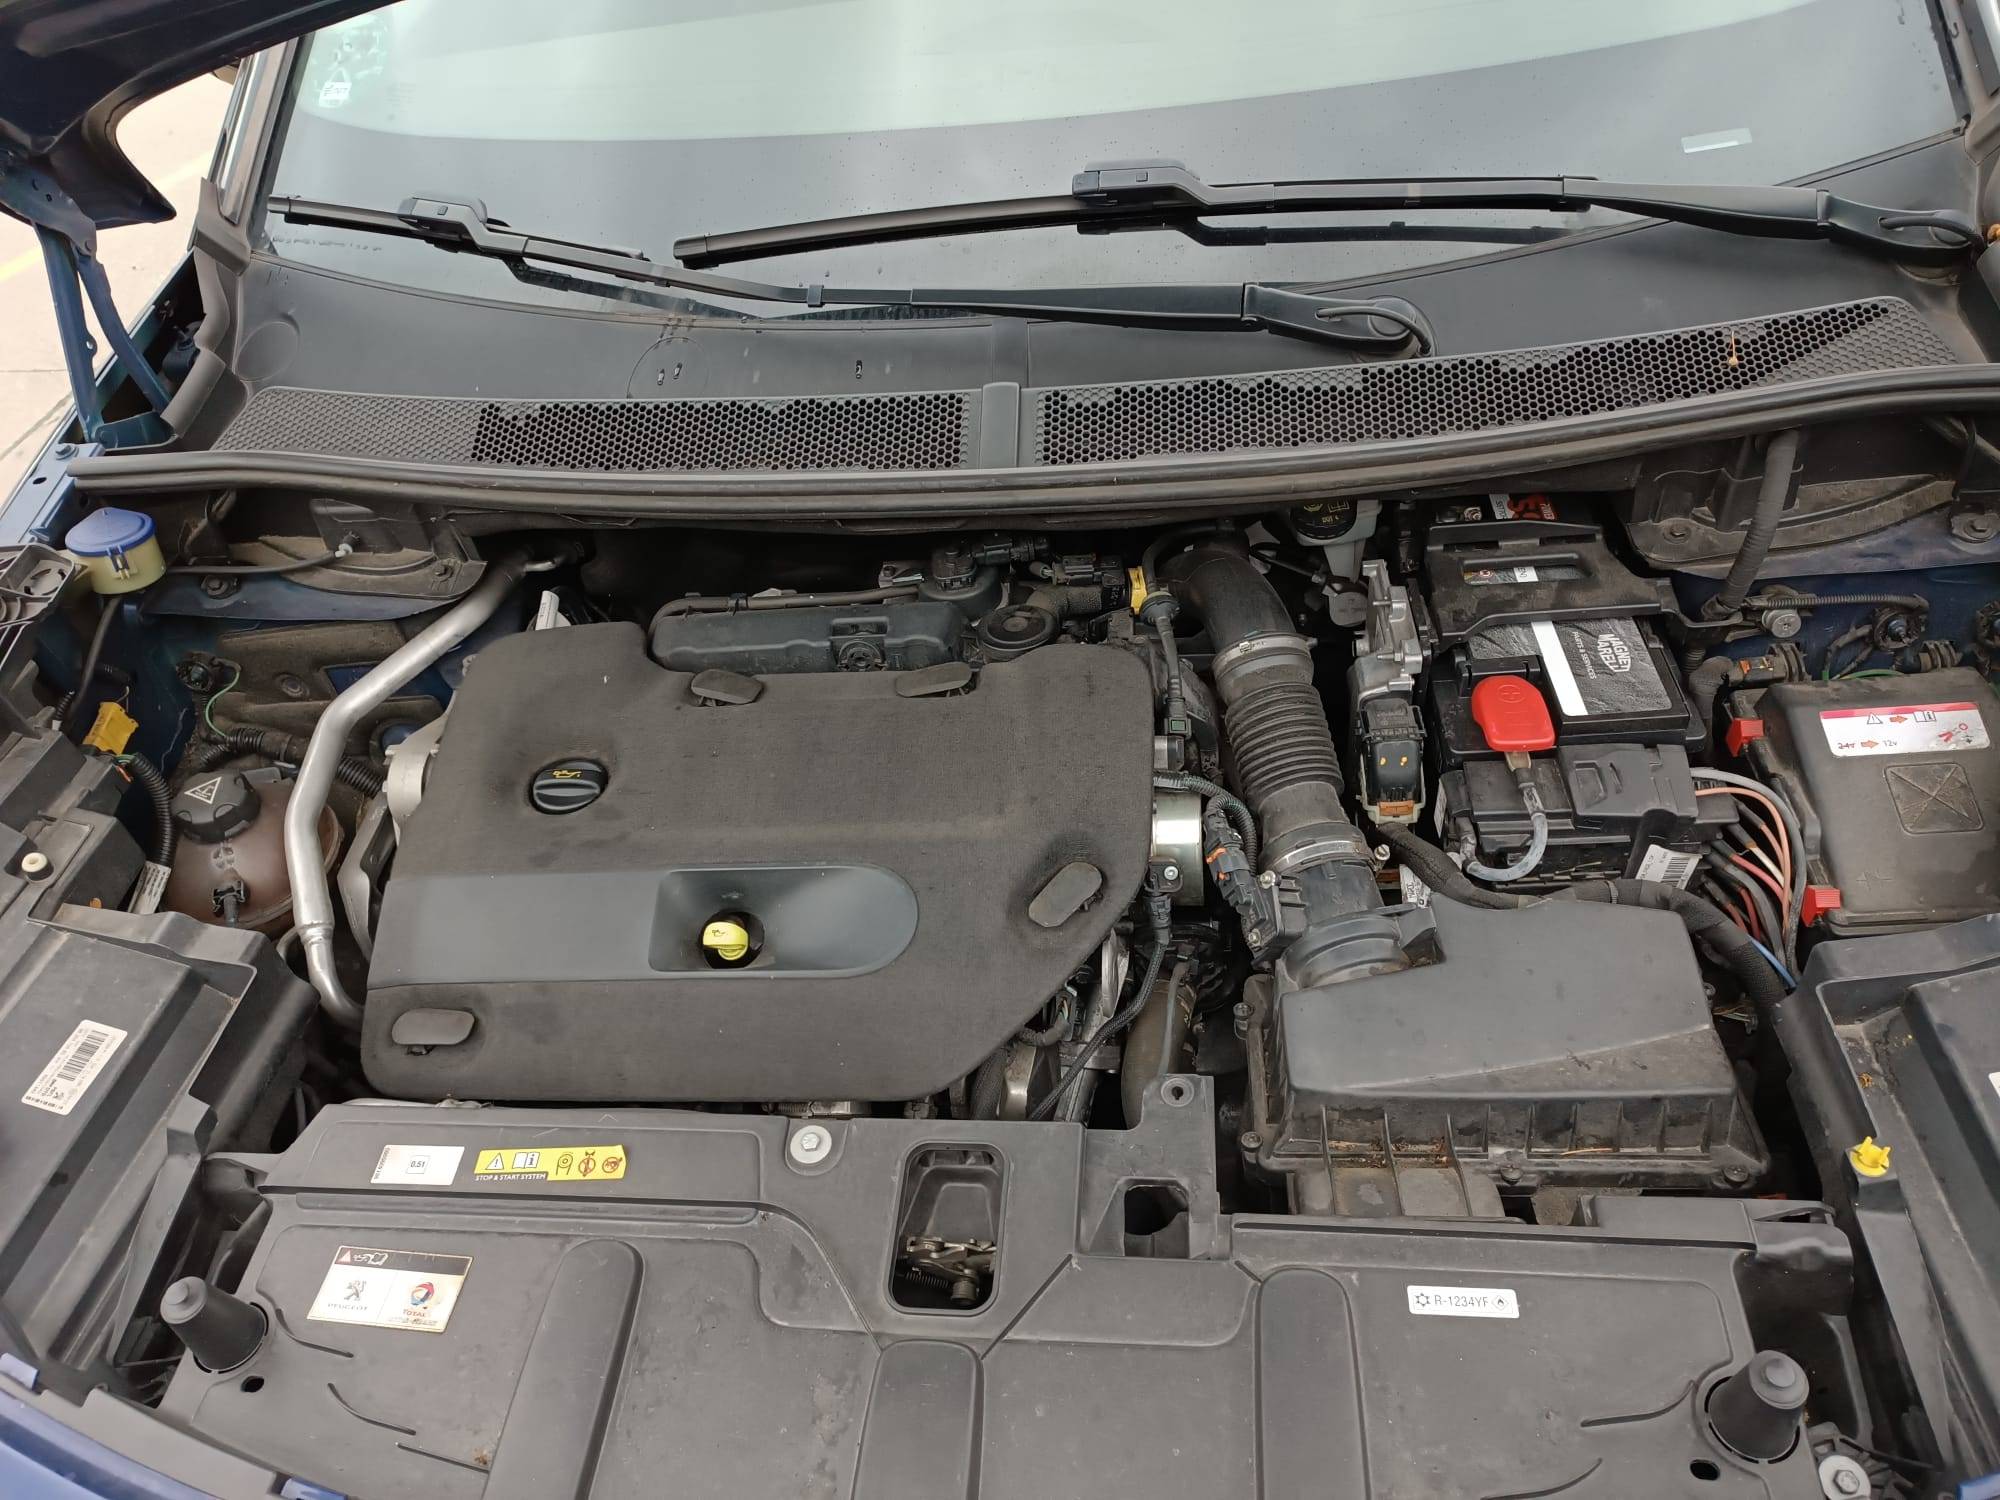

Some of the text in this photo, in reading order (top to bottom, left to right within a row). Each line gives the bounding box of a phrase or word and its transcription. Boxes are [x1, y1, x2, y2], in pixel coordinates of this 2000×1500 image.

[1581, 653, 1597, 680] SERVICES
[499, 1173, 520, 1181] START
[1434, 1295, 1488, 1307] R-1234YF
[403, 1309, 426, 1317] TOTAL
